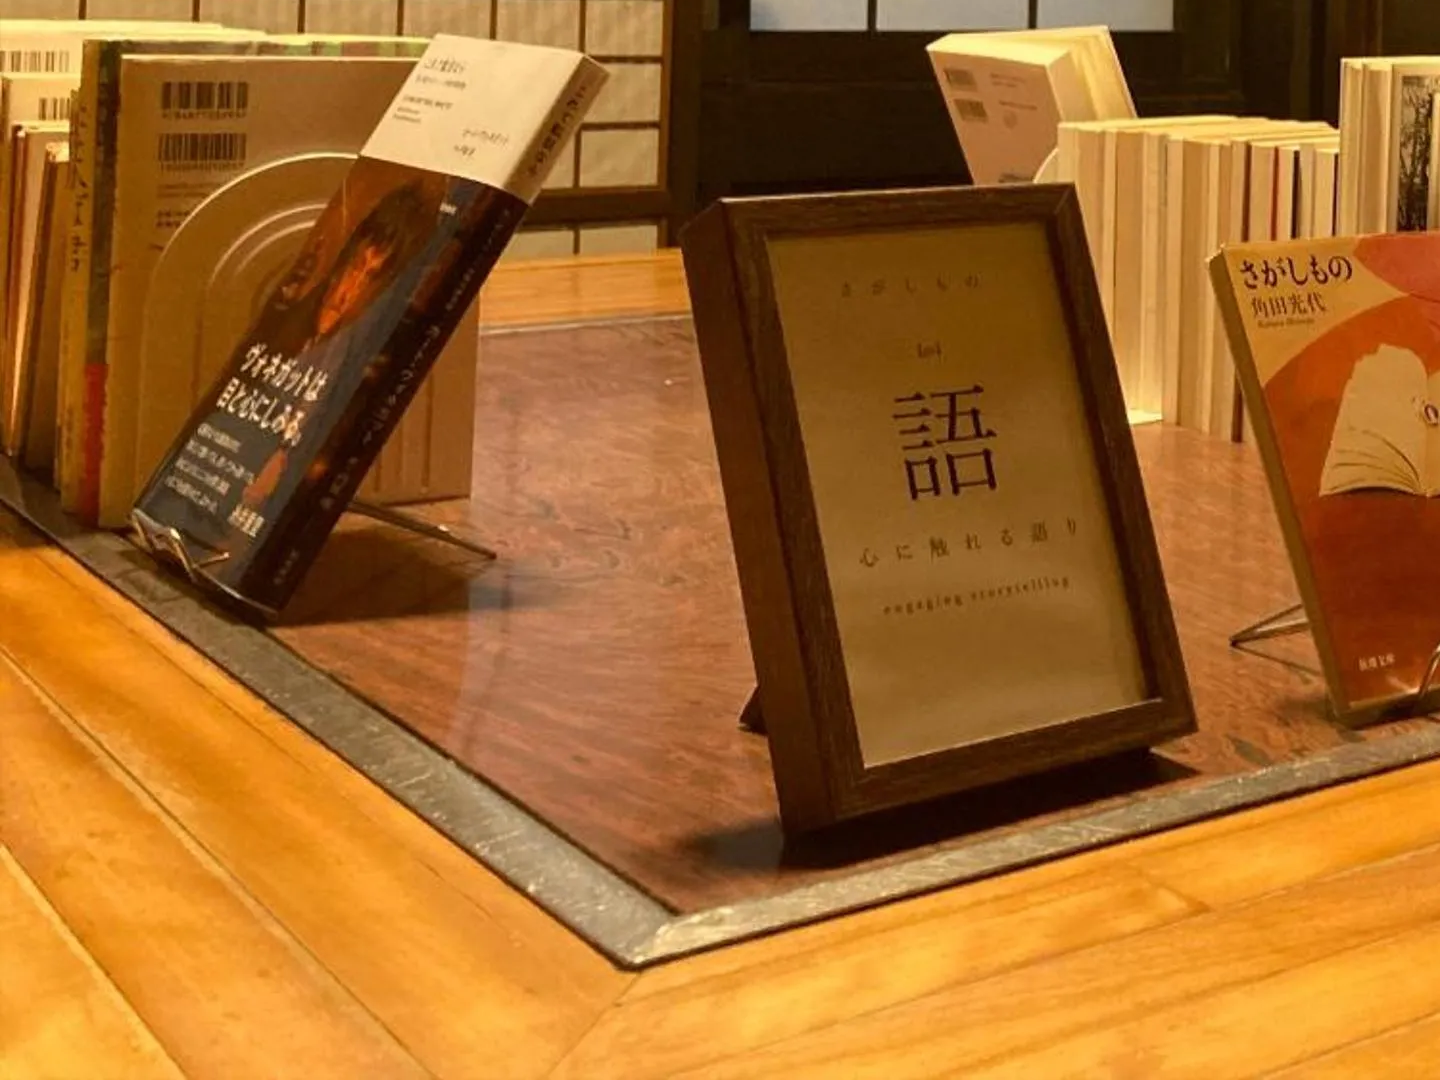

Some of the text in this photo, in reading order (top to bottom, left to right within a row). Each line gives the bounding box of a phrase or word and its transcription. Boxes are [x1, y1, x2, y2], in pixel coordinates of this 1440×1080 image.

[1240, 255, 1354, 290] さがしもの
[1251, 291, 1328, 318] 角田光代
[240, 341, 328, 402] ヴォネガットは
[893, 384, 998, 502] 語
[859, 517, 1077, 568] 心に触れる語り
[882, 593, 964, 617] engaging
